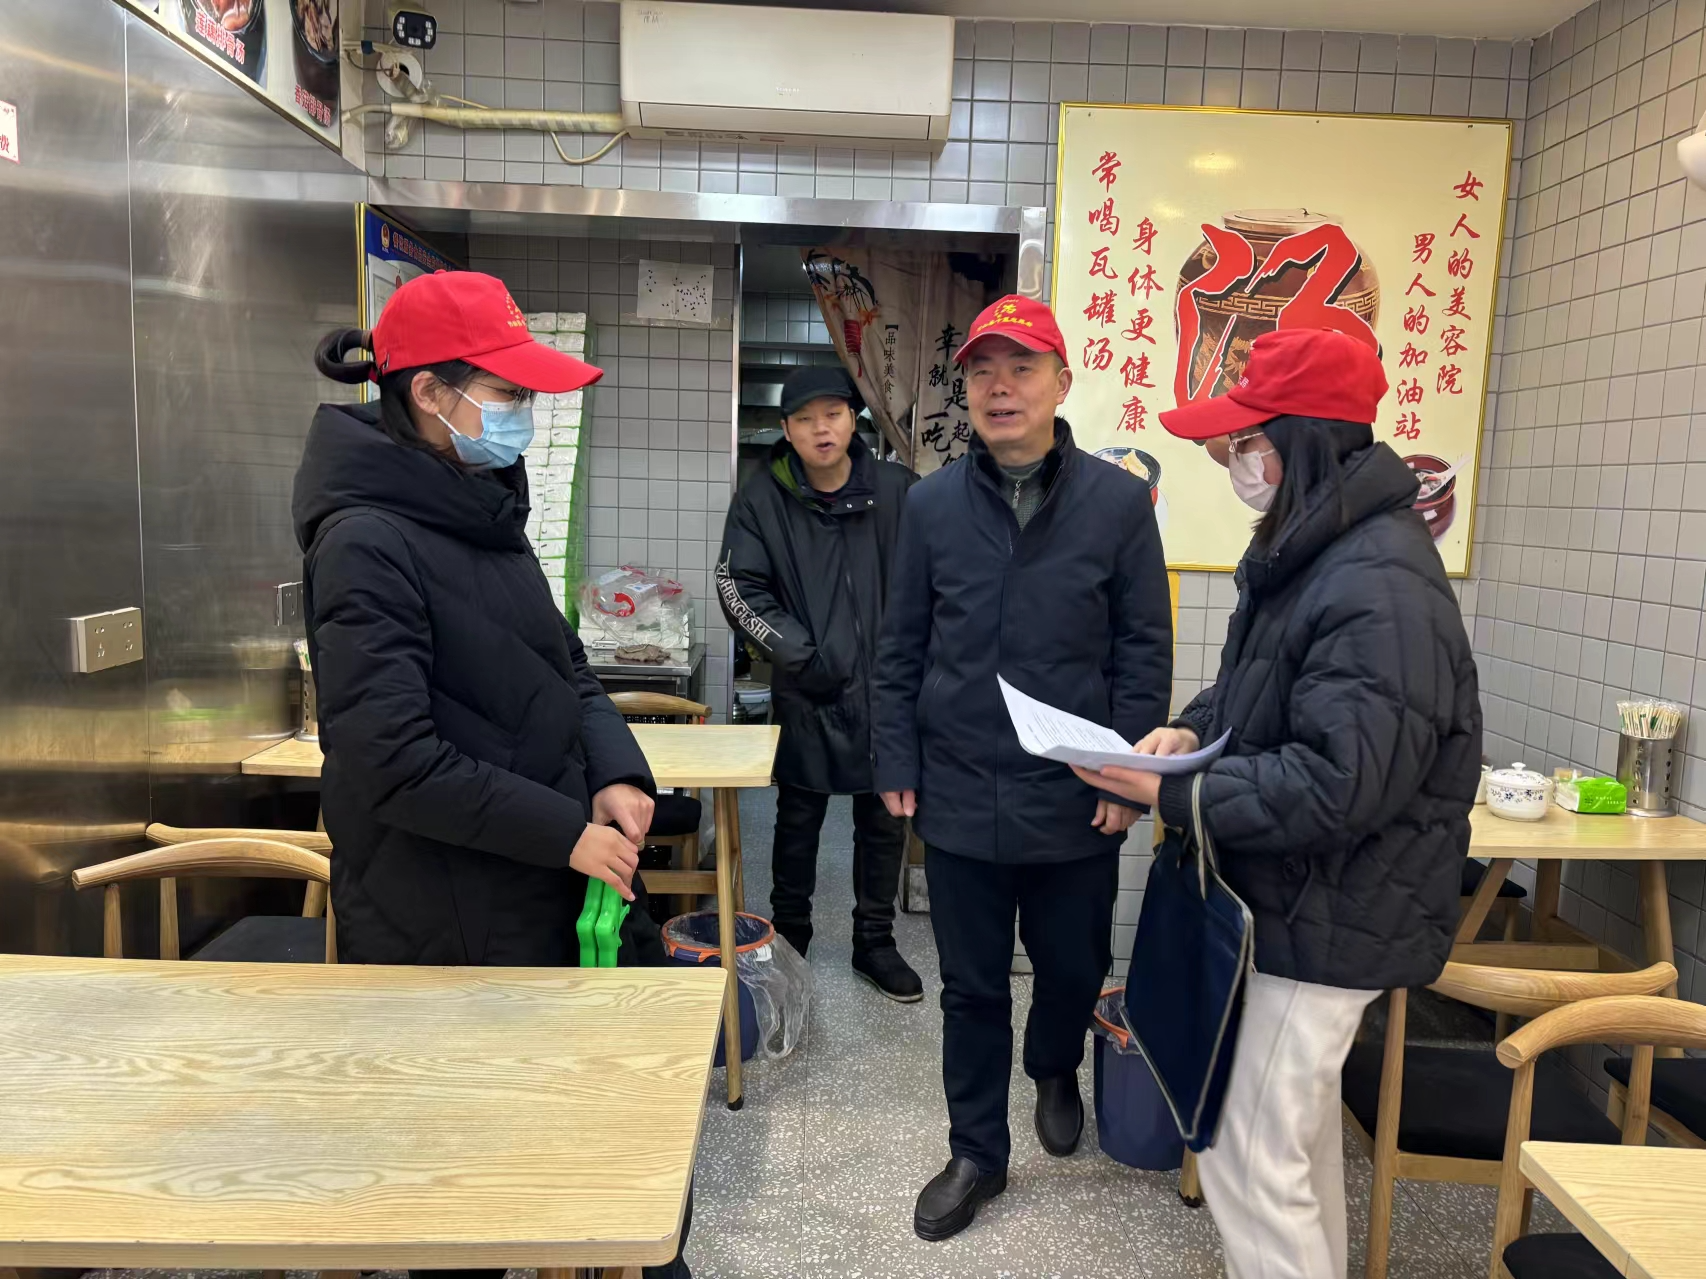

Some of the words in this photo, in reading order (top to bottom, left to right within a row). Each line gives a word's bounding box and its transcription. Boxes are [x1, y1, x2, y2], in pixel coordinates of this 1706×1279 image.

[1082, 150, 1122, 372] 常喝瓦罐汤
[1116, 216, 1164, 434] 身体更健康
[1393, 232, 1437, 441] 男人的加油站
[1436, 170, 1484, 395] 女人的美容院
